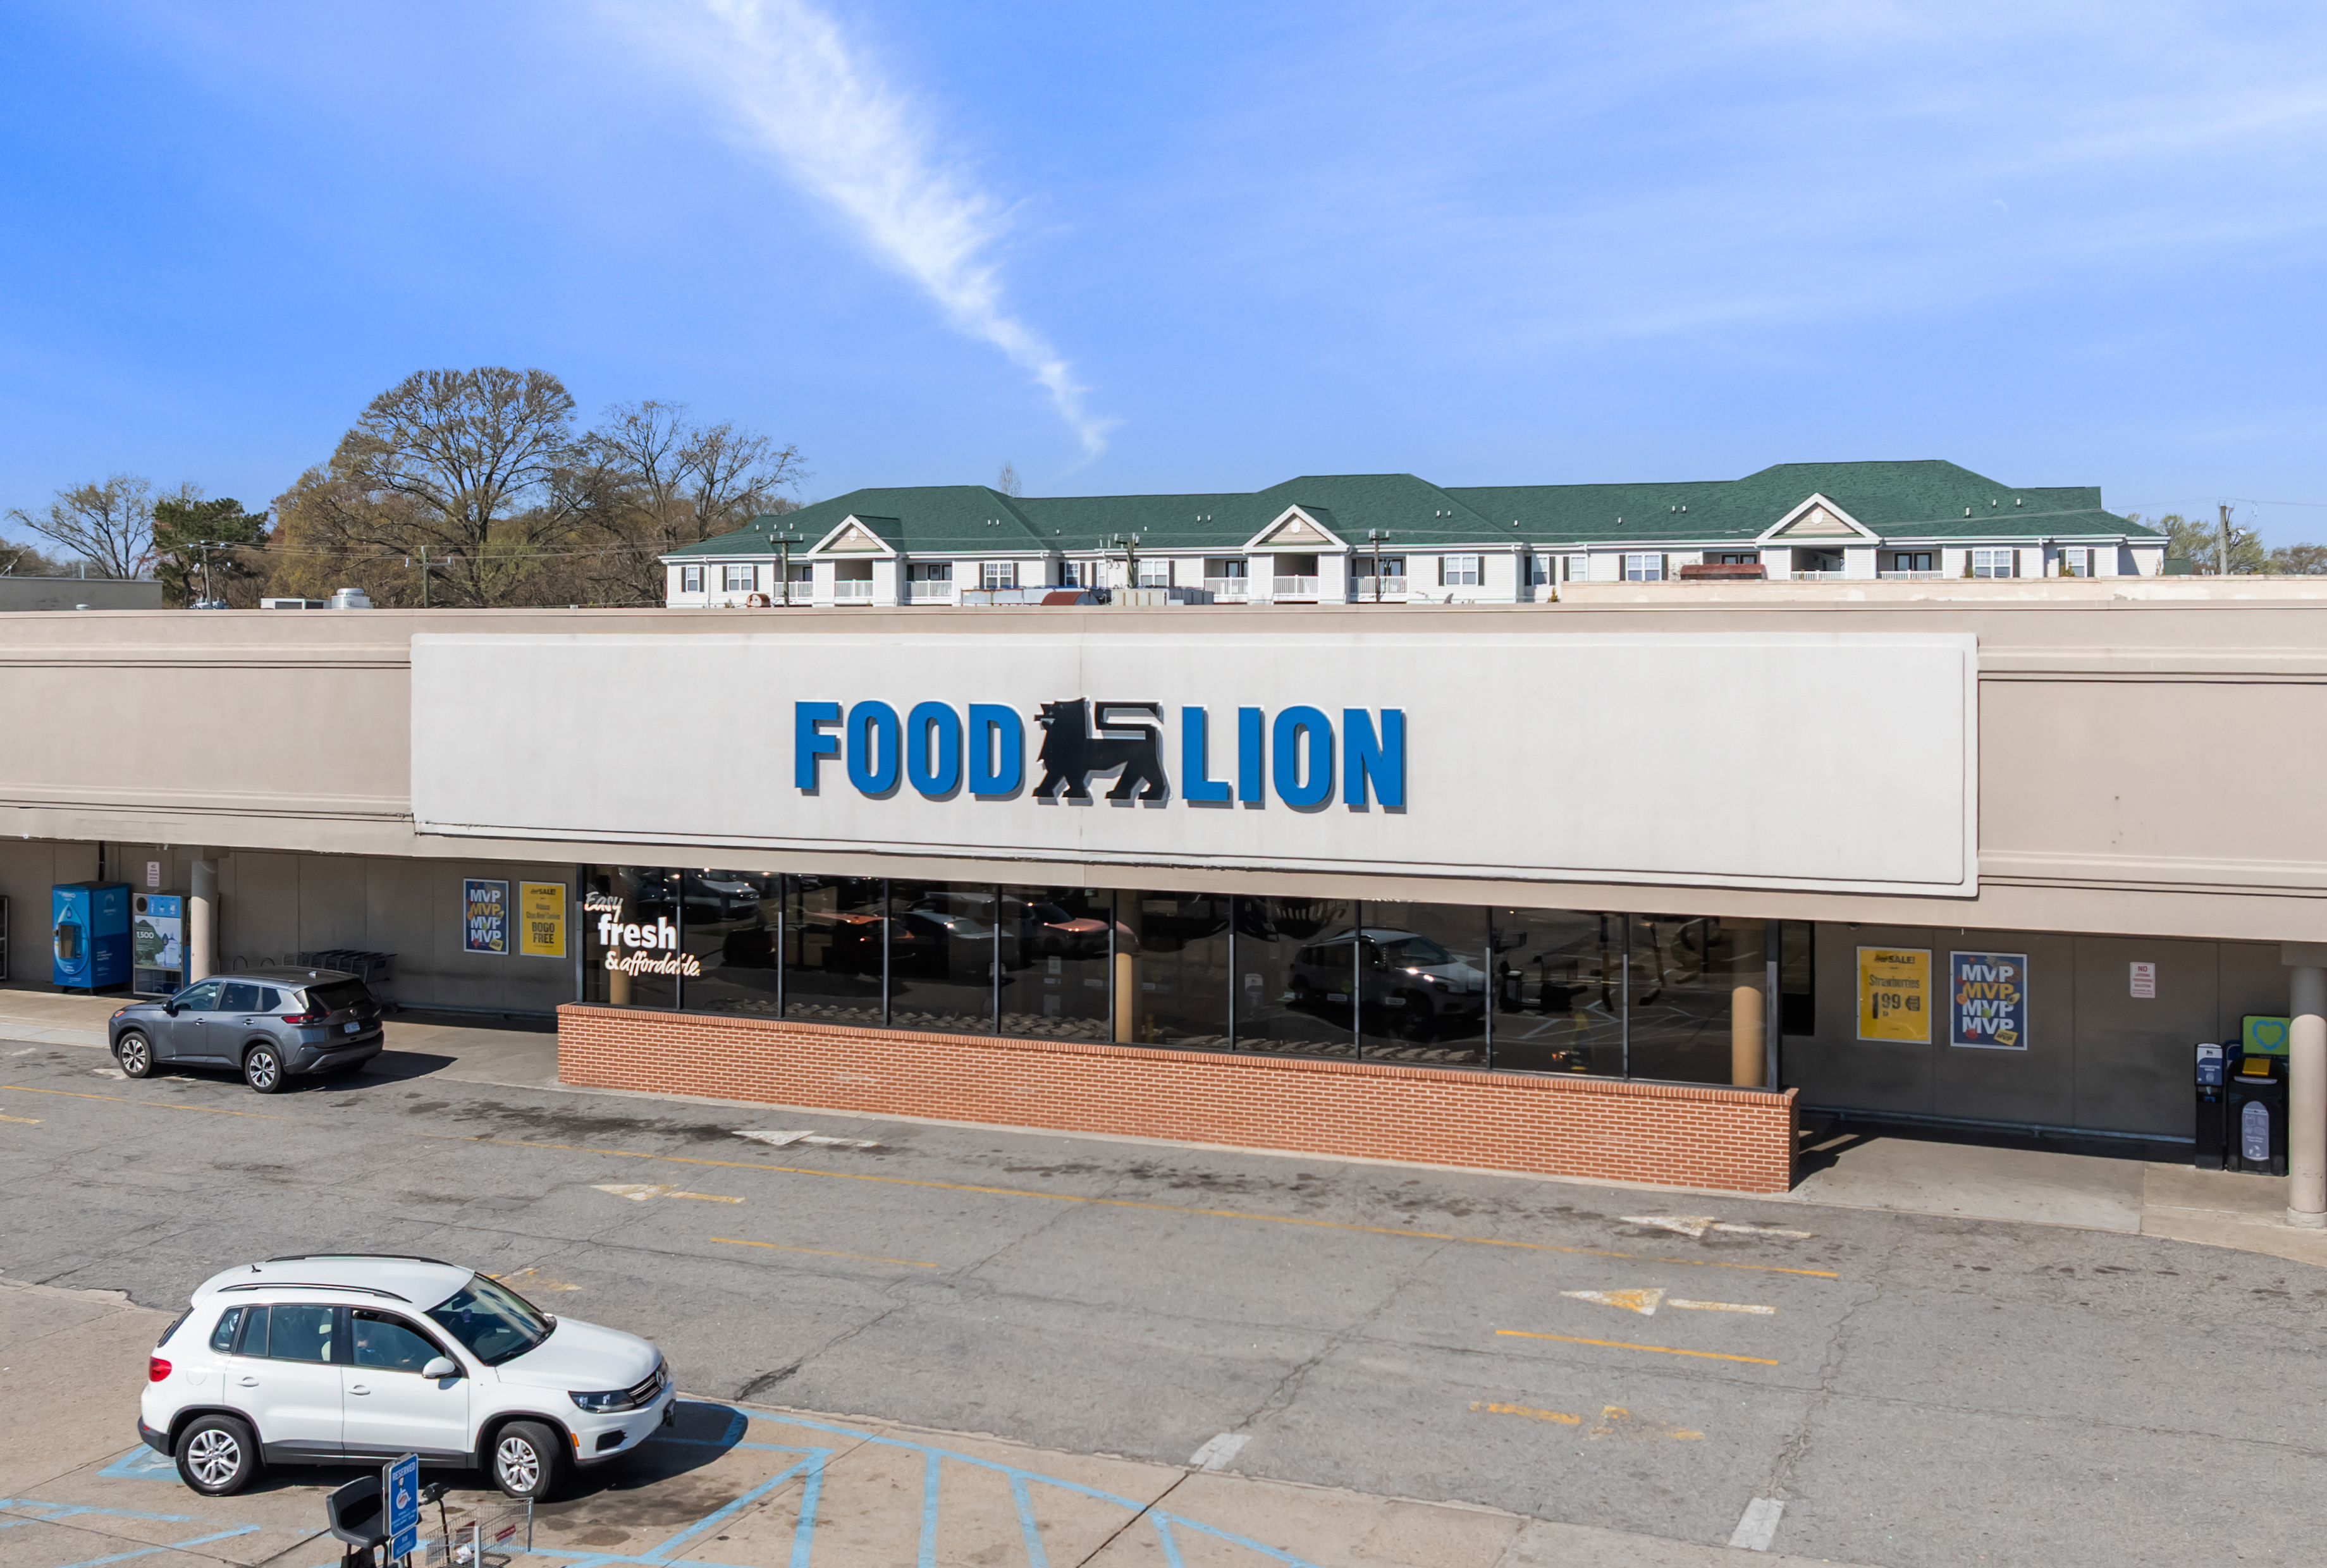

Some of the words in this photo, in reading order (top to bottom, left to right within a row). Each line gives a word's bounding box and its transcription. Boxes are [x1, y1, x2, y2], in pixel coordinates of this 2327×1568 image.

[795, 699, 1023, 798] FOOD
[1182, 704, 1405, 808] LION
[470, 889, 501, 902] MVP
[470, 902, 501, 916] MVP
[584, 891, 623, 922] Easy
[470, 916, 501, 929] MVP
[532, 922, 555, 933] BOGO
[470, 929, 502, 943] MVP
[533, 933, 555, 944] FREE
[598, 913, 677, 950] fresh
[1888, 955, 1915, 964] SALE!
[1962, 964, 2014, 982] MVP
[1869, 974, 1920, 989] Strawberries
[1962, 982, 2015, 1000] MVP
[1962, 999, 2015, 1017] MVP
[1962, 1016, 2015, 1034] MVP
[392, 1462, 415, 1482] RESERVED
